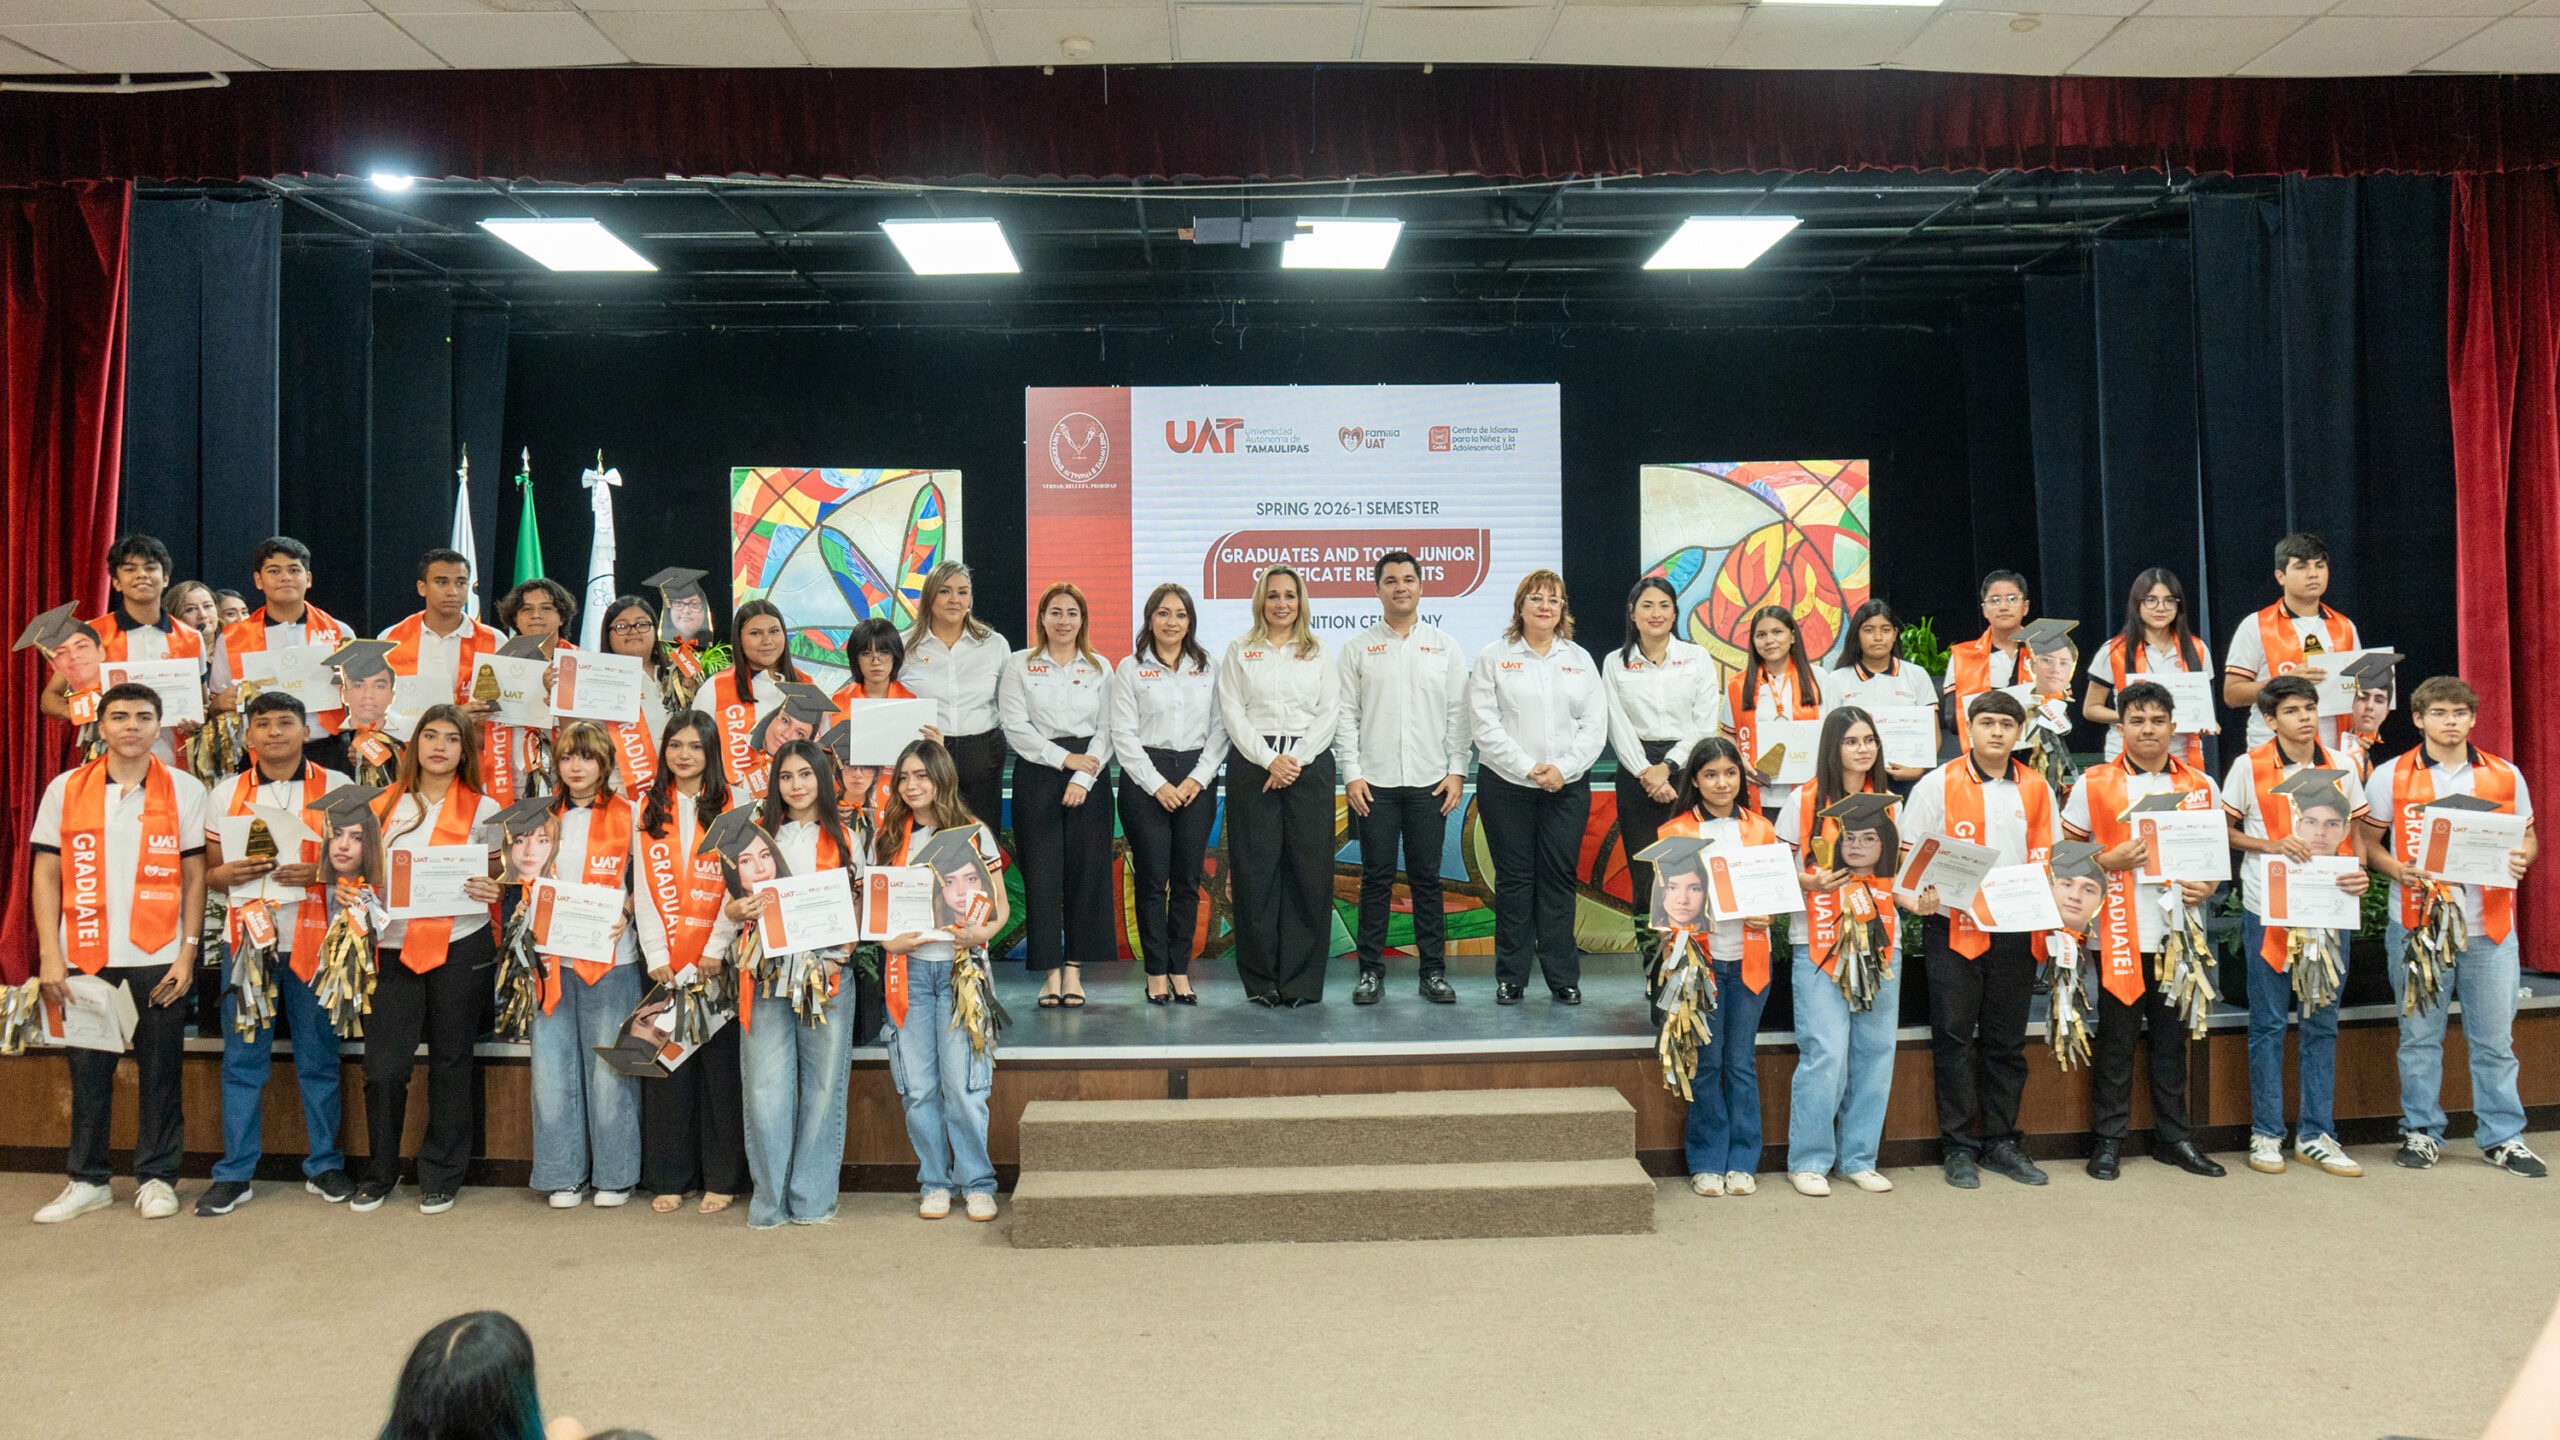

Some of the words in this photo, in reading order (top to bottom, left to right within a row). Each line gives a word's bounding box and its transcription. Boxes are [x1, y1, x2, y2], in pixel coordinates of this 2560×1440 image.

[1166, 417, 1245, 453] UAT
[1245, 427, 1293, 435] Universidad
[1245, 435, 1289, 443] Autónoma
[1290, 435, 1301, 443] de
[1366, 438, 1385, 449] UAT
[1452, 436, 1469, 444] para
[1480, 435, 1500, 443] Niñez
[1245, 444, 1310, 453] TAMAULIPAS
[1452, 444, 1501, 452] Adolescencia
[1256, 502, 1309, 516] SPRING
[1314, 502, 1362, 515] 2026-1
[1367, 501, 1439, 515] SEMESTER
[1221, 548, 1319, 563] GRADUATES
[1323, 547, 1359, 562] AND
[1415, 547, 1475, 562] JUNIOR
[1310, 615, 1356, 629] NITION
[1367, 644, 1387, 652] UAT
[1027, 665, 1050, 673] UAT
[1501, 661, 1524, 669] UAT
[1139, 670, 1161, 678] UAT
[281, 680, 304, 690] UAT
[503, 690, 525, 700] UAT
[400, 707, 420, 717] UAT
[726, 704, 752, 784] GRADUA
[1788, 751, 1808, 760] UAT
[148, 835, 177, 849] UAT
[591, 856, 621, 869] UAT
[72, 833, 99, 939] GRADUATE
[780, 891, 795, 899] UAT
